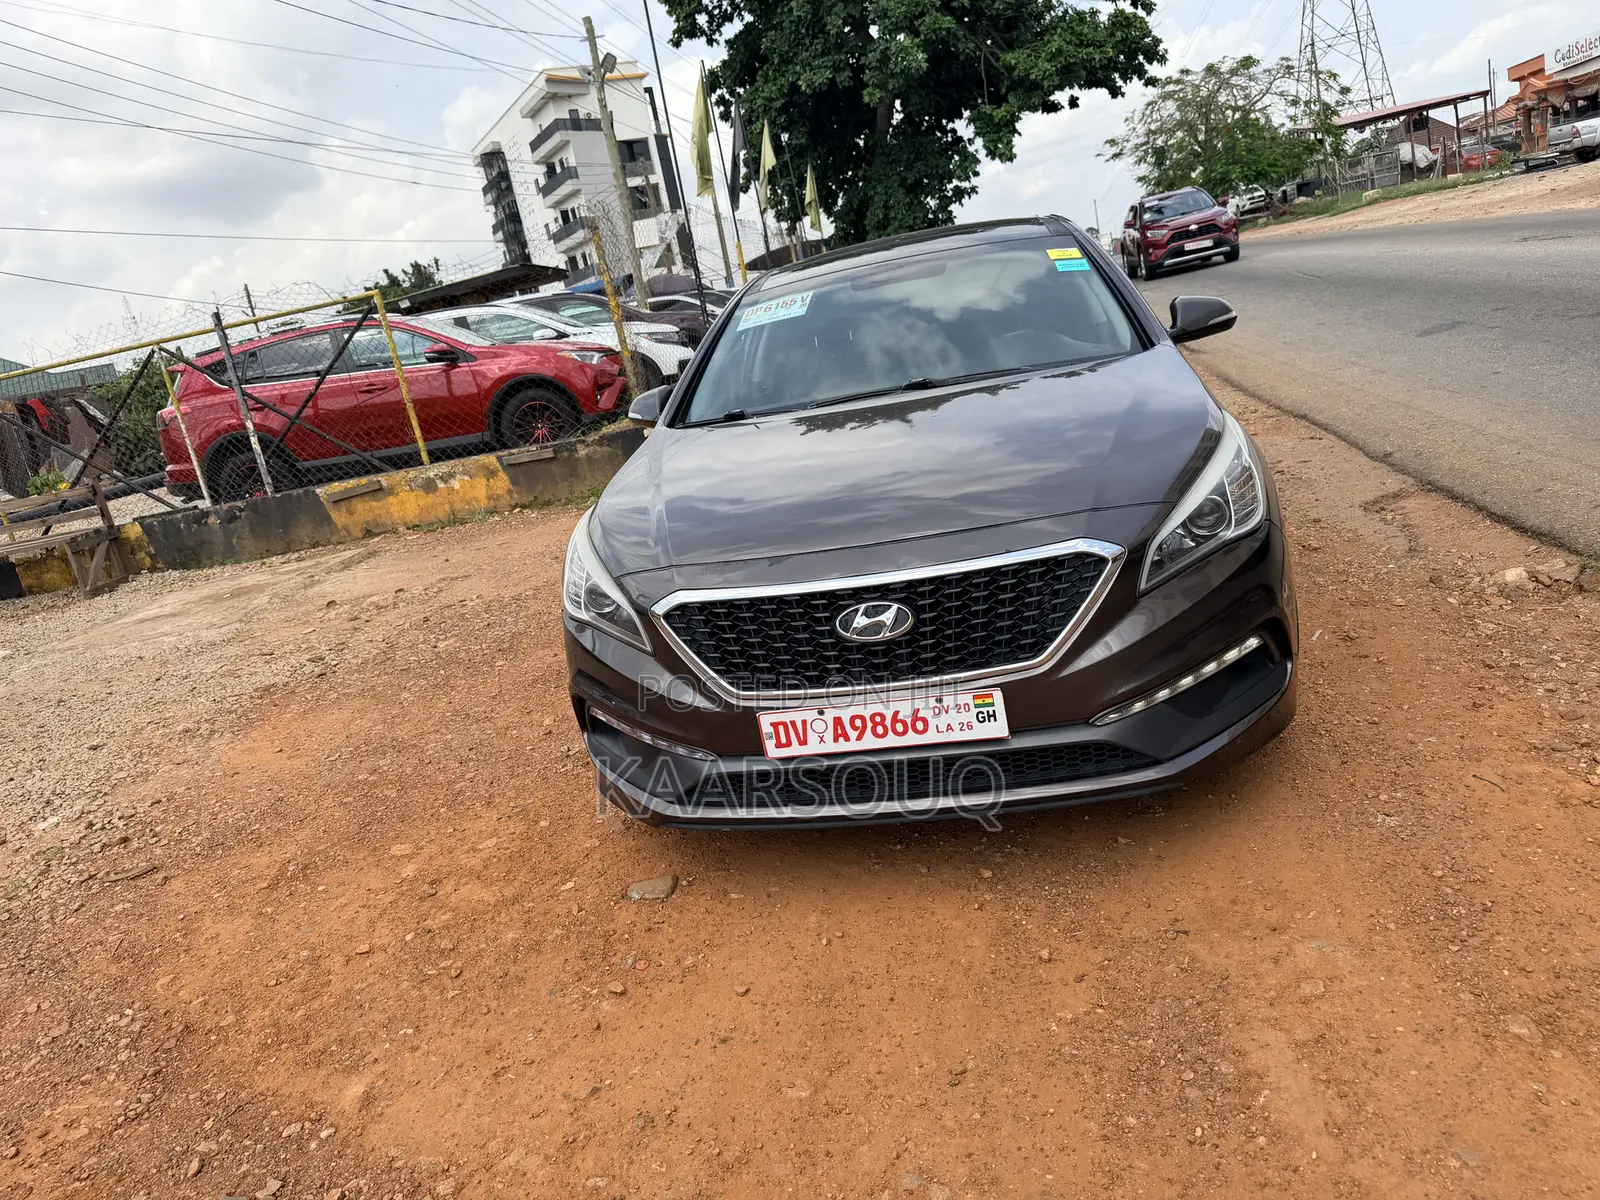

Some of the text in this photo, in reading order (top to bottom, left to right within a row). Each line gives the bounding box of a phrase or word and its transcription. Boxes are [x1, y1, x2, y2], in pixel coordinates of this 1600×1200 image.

[932, 703, 971, 716] DV 20
[976, 709, 998, 724] GH
[770, 707, 929, 749] DV A9866
[936, 721, 974, 734] LA 26
